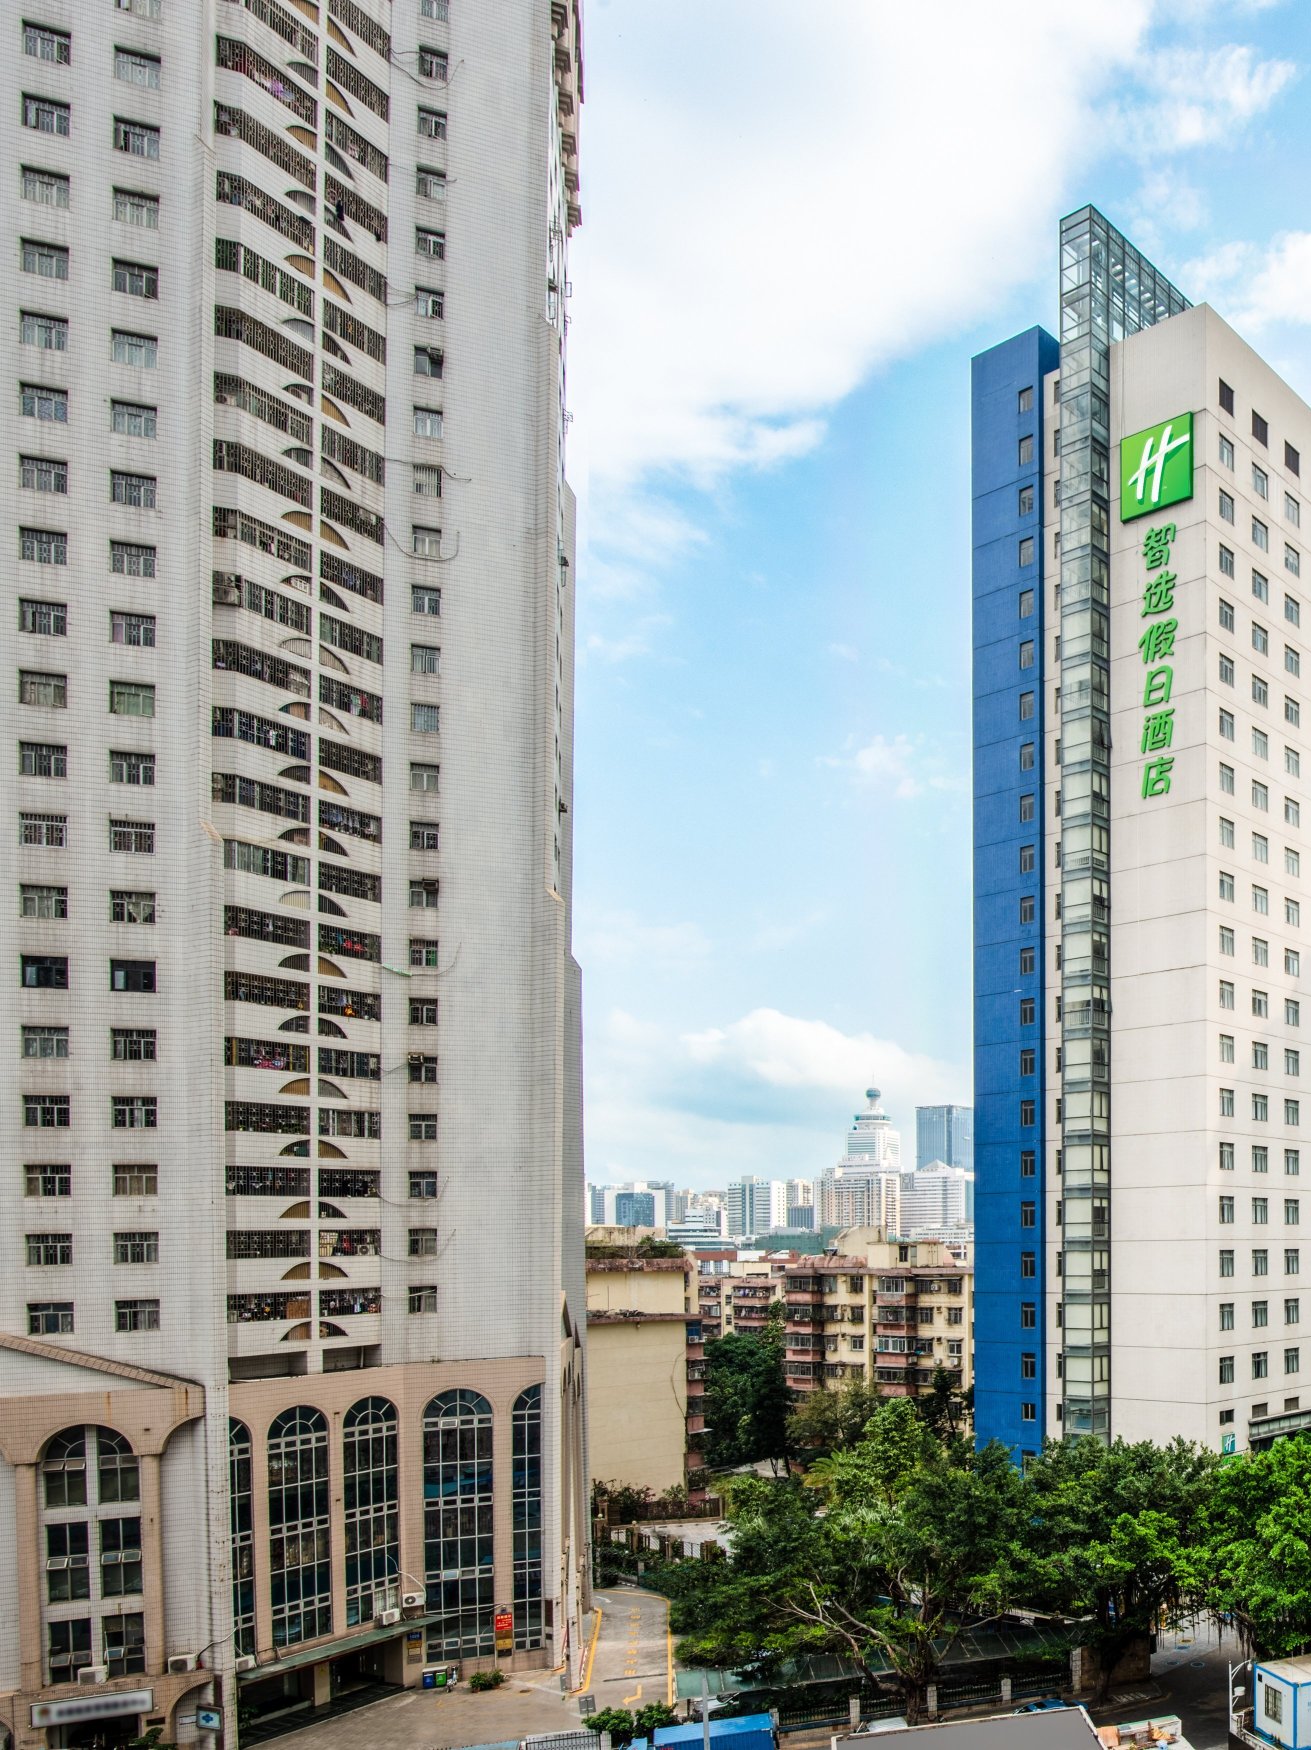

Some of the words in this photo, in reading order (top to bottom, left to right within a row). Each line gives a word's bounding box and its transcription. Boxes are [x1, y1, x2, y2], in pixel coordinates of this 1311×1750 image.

[1128, 425, 1190, 503] H
[1138, 522, 1178, 799] 智选假日酒店
